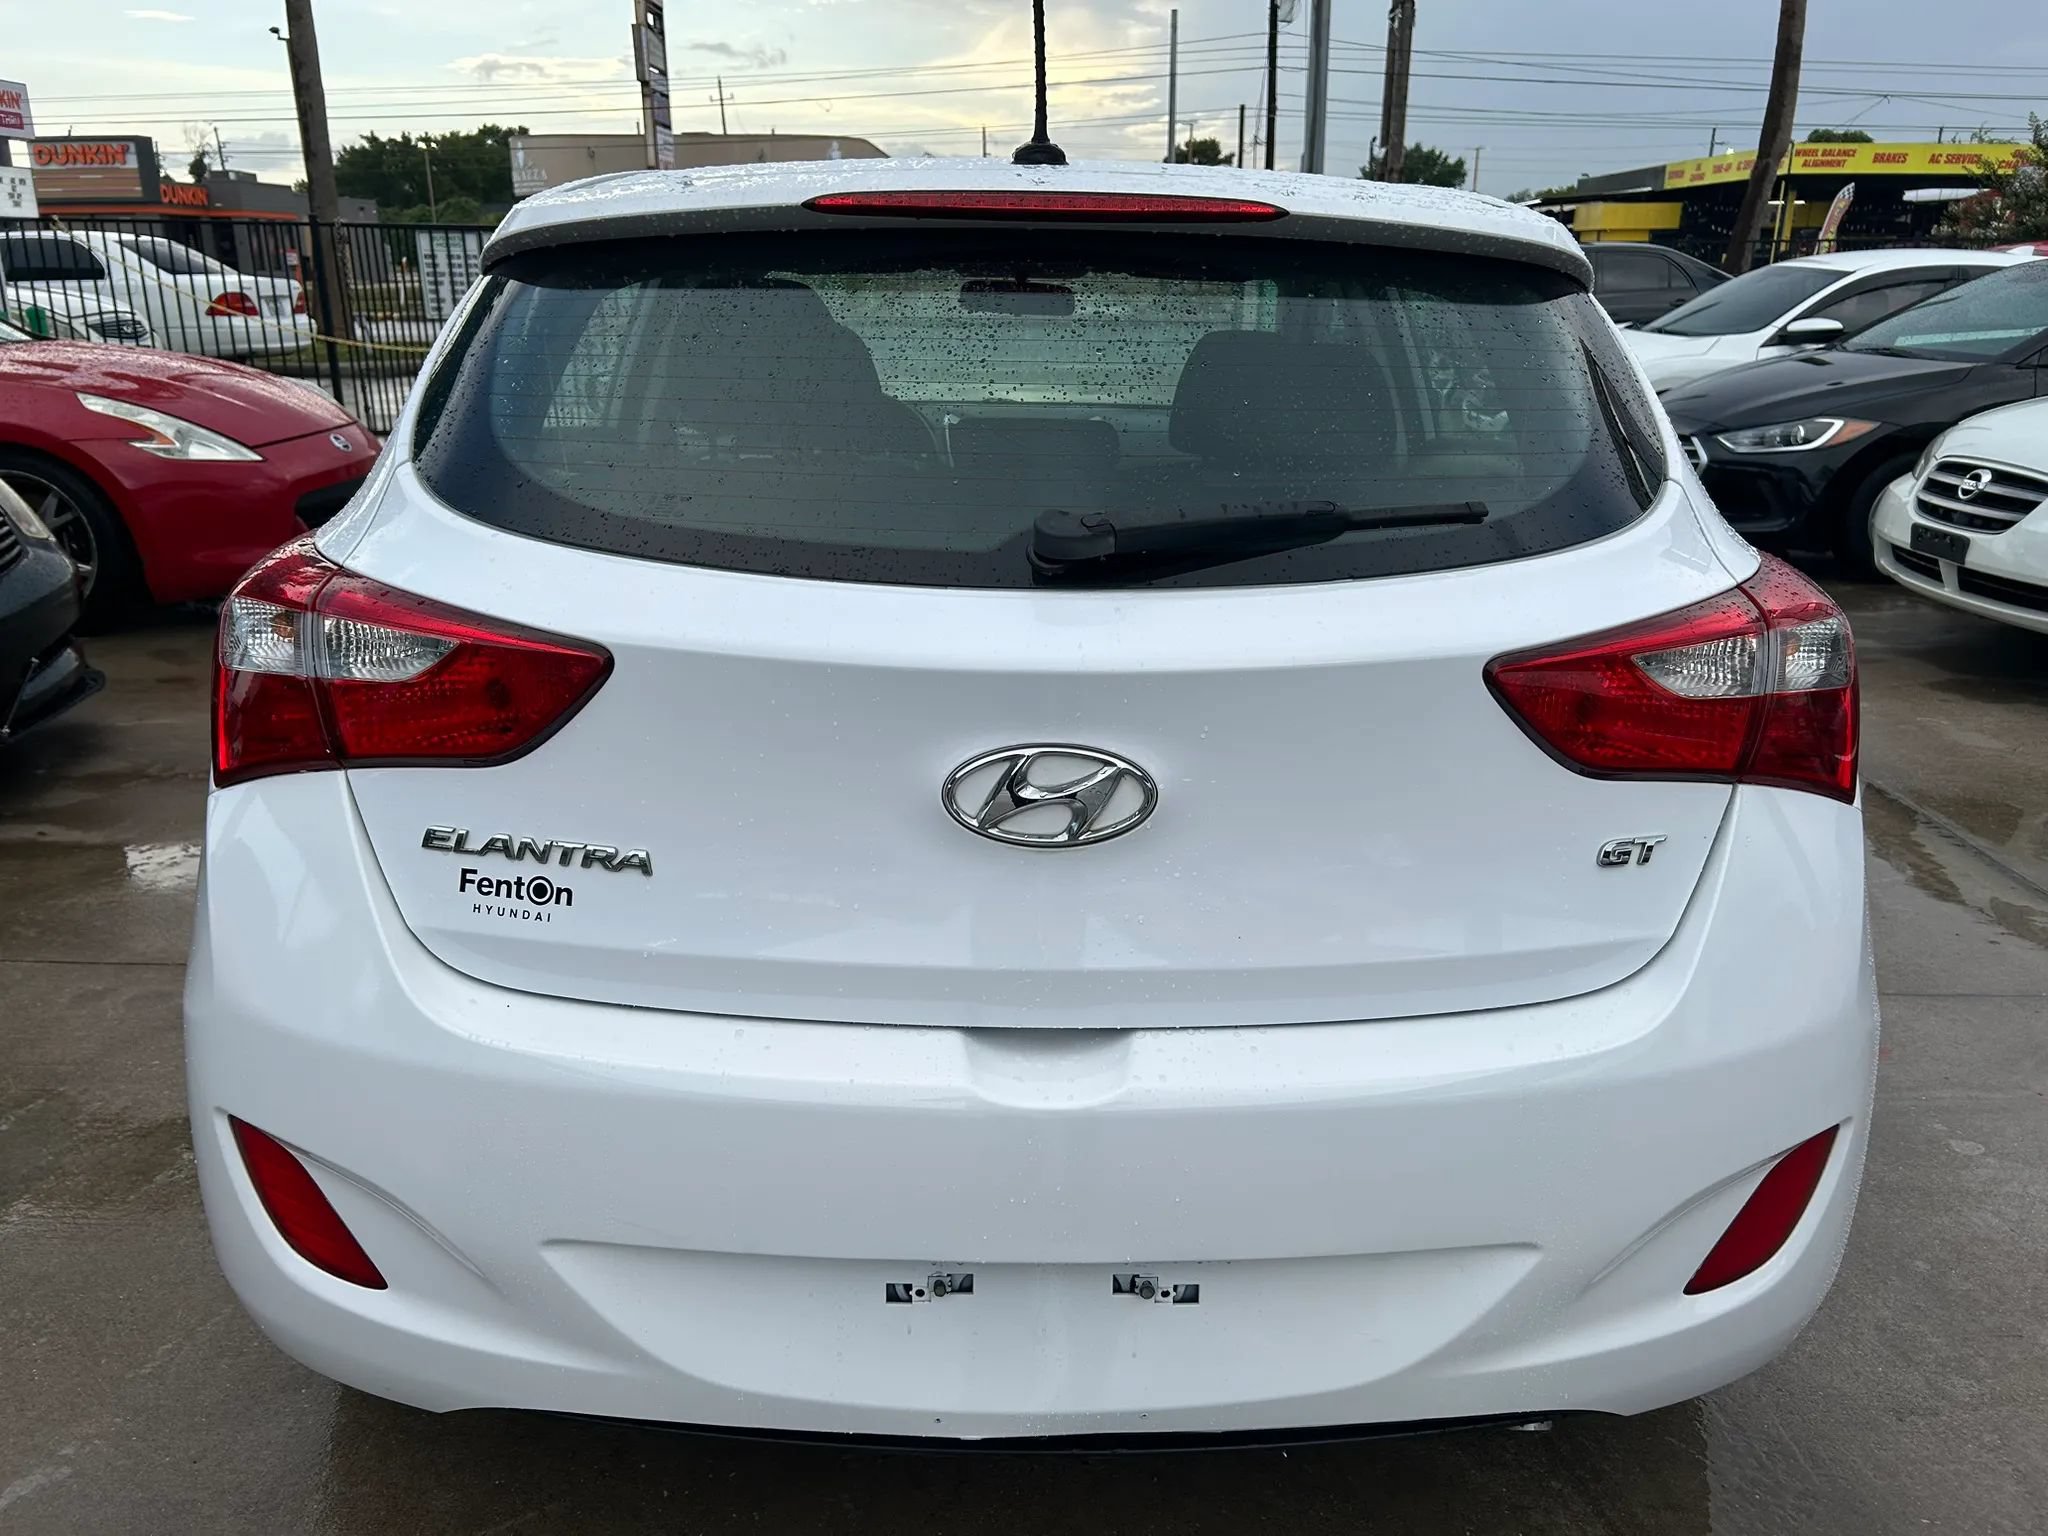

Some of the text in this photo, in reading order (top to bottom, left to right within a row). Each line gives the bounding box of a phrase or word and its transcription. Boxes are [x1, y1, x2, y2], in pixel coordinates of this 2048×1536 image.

[33, 143, 130, 166] DUNKIN'
[1795, 148, 1858, 158] WHEEL BALANCE
[1872, 152, 1909, 164] BRAKES
[1928, 153, 1982, 165] AC SERVICE
[1802, 159, 1848, 168] ALIGNMENT
[421, 825, 654, 877] ELANTRA
[1596, 833, 1668, 867] GT
[472, 903, 552, 923] HYUNDAI
